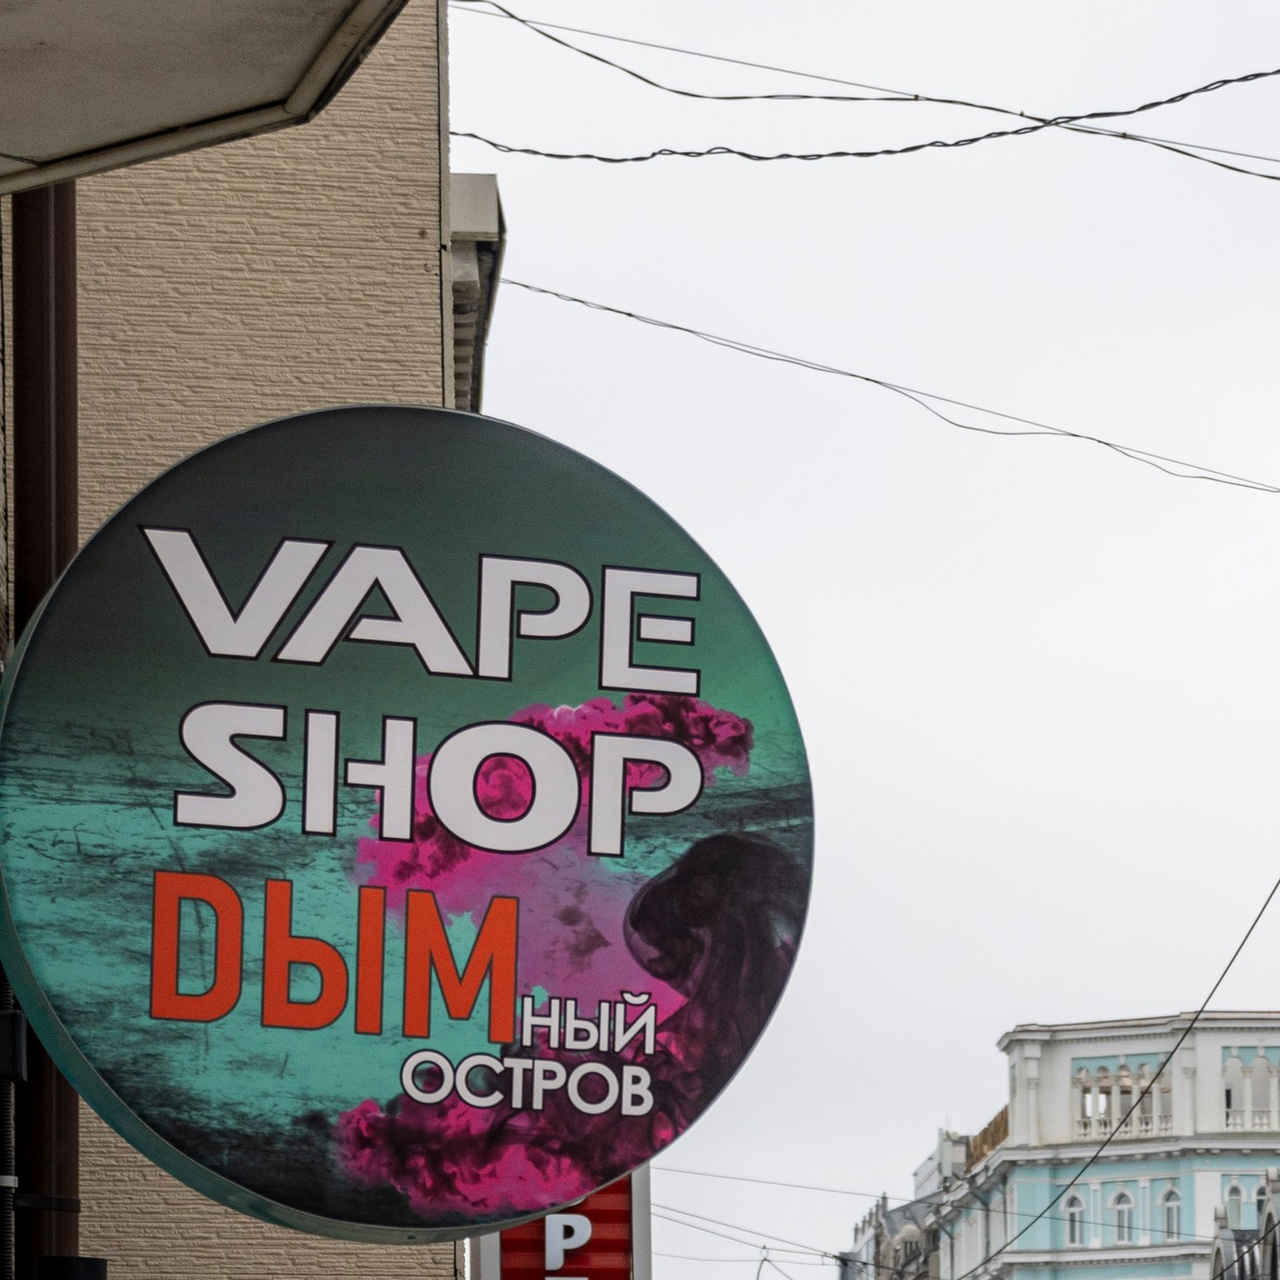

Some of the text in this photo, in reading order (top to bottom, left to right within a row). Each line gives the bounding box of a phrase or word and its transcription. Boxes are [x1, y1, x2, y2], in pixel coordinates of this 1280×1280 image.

[139, 524, 701, 698] VAPE
[174, 701, 705, 859] SHOP
[400, 1048, 656, 1117] ОСТРОВ
